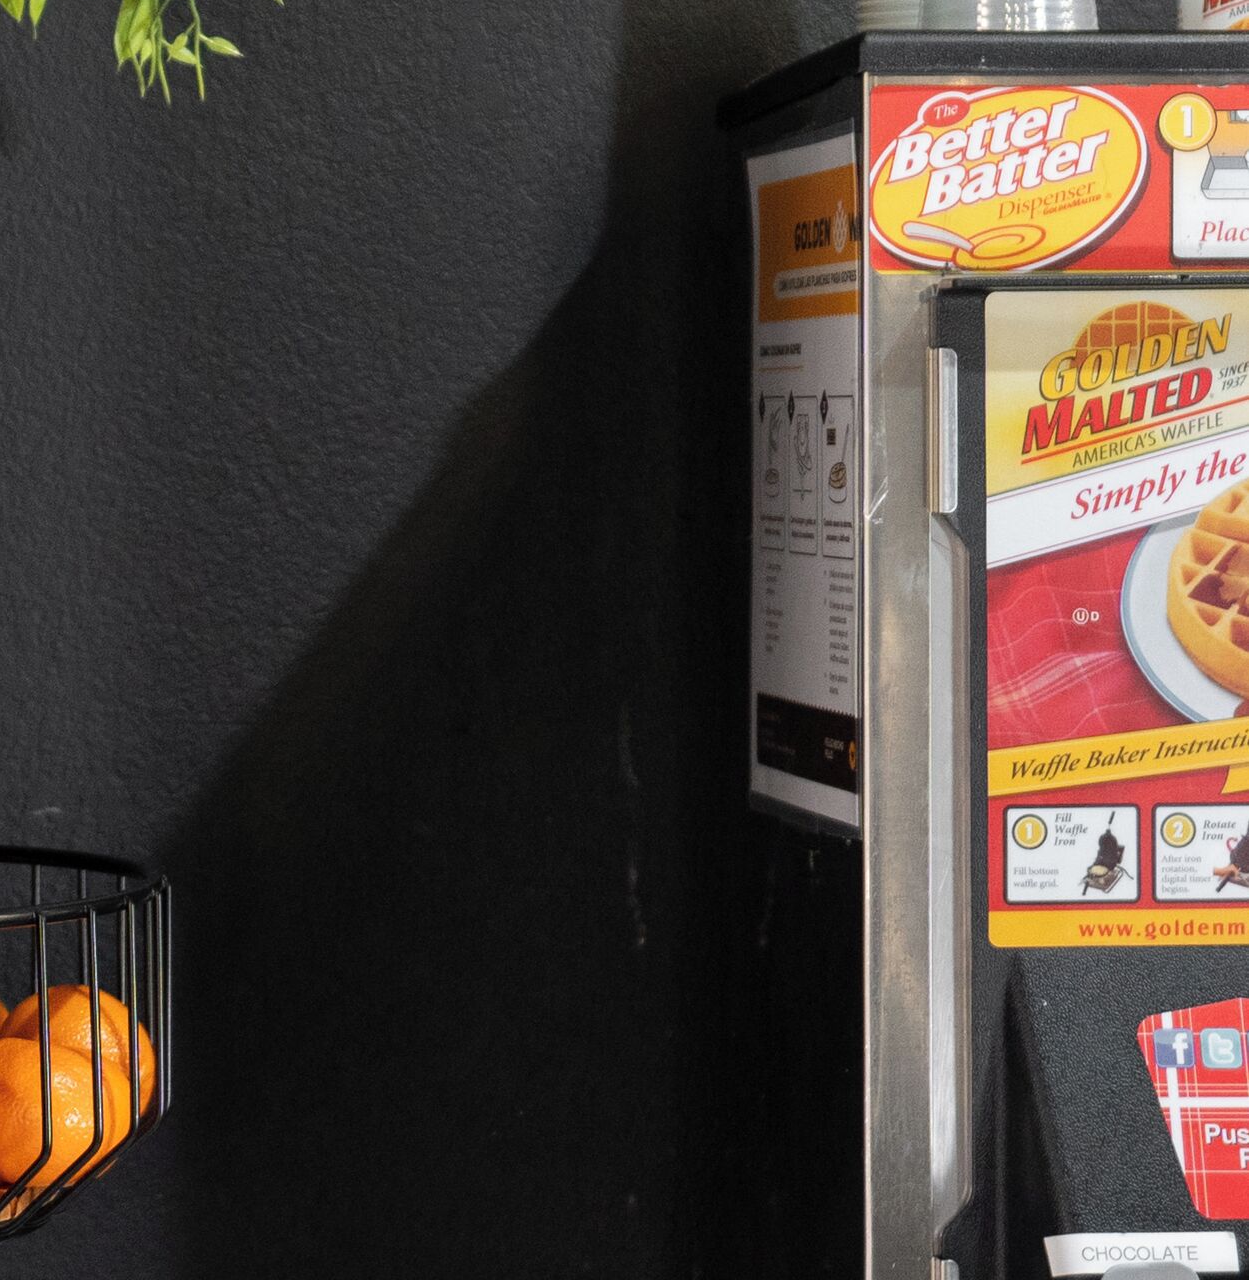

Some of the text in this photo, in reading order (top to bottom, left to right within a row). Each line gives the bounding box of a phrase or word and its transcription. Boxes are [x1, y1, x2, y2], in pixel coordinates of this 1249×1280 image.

[934, 103, 959, 119] The
[1181, 104, 1192, 138] 1
[886, 96, 1079, 184] Better
[919, 130, 1109, 218] Batter
[998, 180, 1096, 219] Dispenser
[794, 216, 831, 250] GOLDEN
[1200, 220, 1249, 243] Plac
[1040, 313, 1232, 401] GOLDEN
[1222, 374, 1247, 391] 1937
[1022, 367, 1213, 455] MALTED
[1073, 411, 1224, 468] AMERICA'S WAFFLE
[1071, 449, 1247, 520] Simply the
[1010, 729, 1249, 780] Waffle Baker Instructi
[1054, 812, 1072, 823] Fill
[1202, 819, 1237, 830] Rotate
[1025, 823, 1033, 840] 1
[1054, 824, 1089, 837] Waffle
[1172, 821, 1184, 838] 2
[1202, 831, 1224, 841] Iron
[1054, 837, 1076, 846] Iron
[1162, 854, 1202, 863] After iron
[1013, 866, 1059, 875] Fill bottom
[1162, 874, 1211, 884] digital timer
[1013, 879, 1038, 888] waffle
[1079, 919, 1246, 940] www.goldenm
[1204, 1123, 1249, 1145] Pus
[1081, 1245, 1199, 1262] CHOCOLATE
